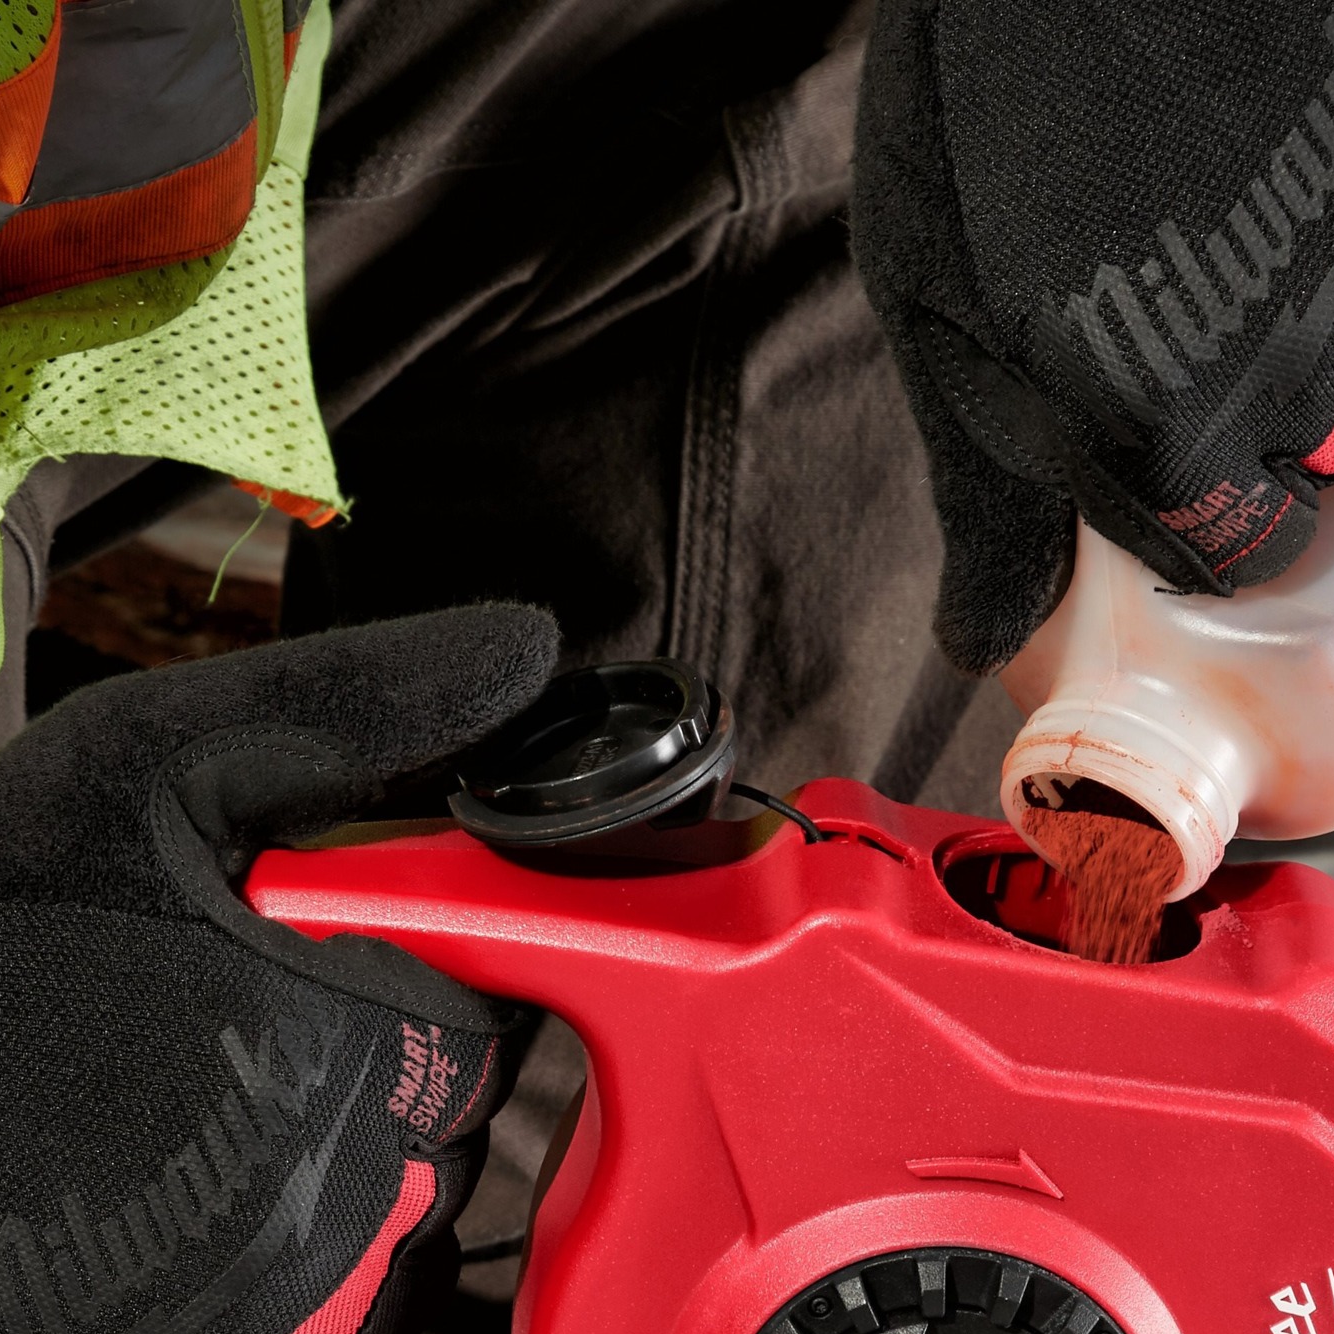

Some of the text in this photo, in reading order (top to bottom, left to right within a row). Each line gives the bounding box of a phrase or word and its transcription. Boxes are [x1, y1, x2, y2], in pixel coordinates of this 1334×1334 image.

[1156, 480, 1243, 531] SMART
[1187, 498, 1269, 553] SWIPE
[388, 1021, 428, 1118] SMART
[408, 1046, 458, 1133] SWIPE
